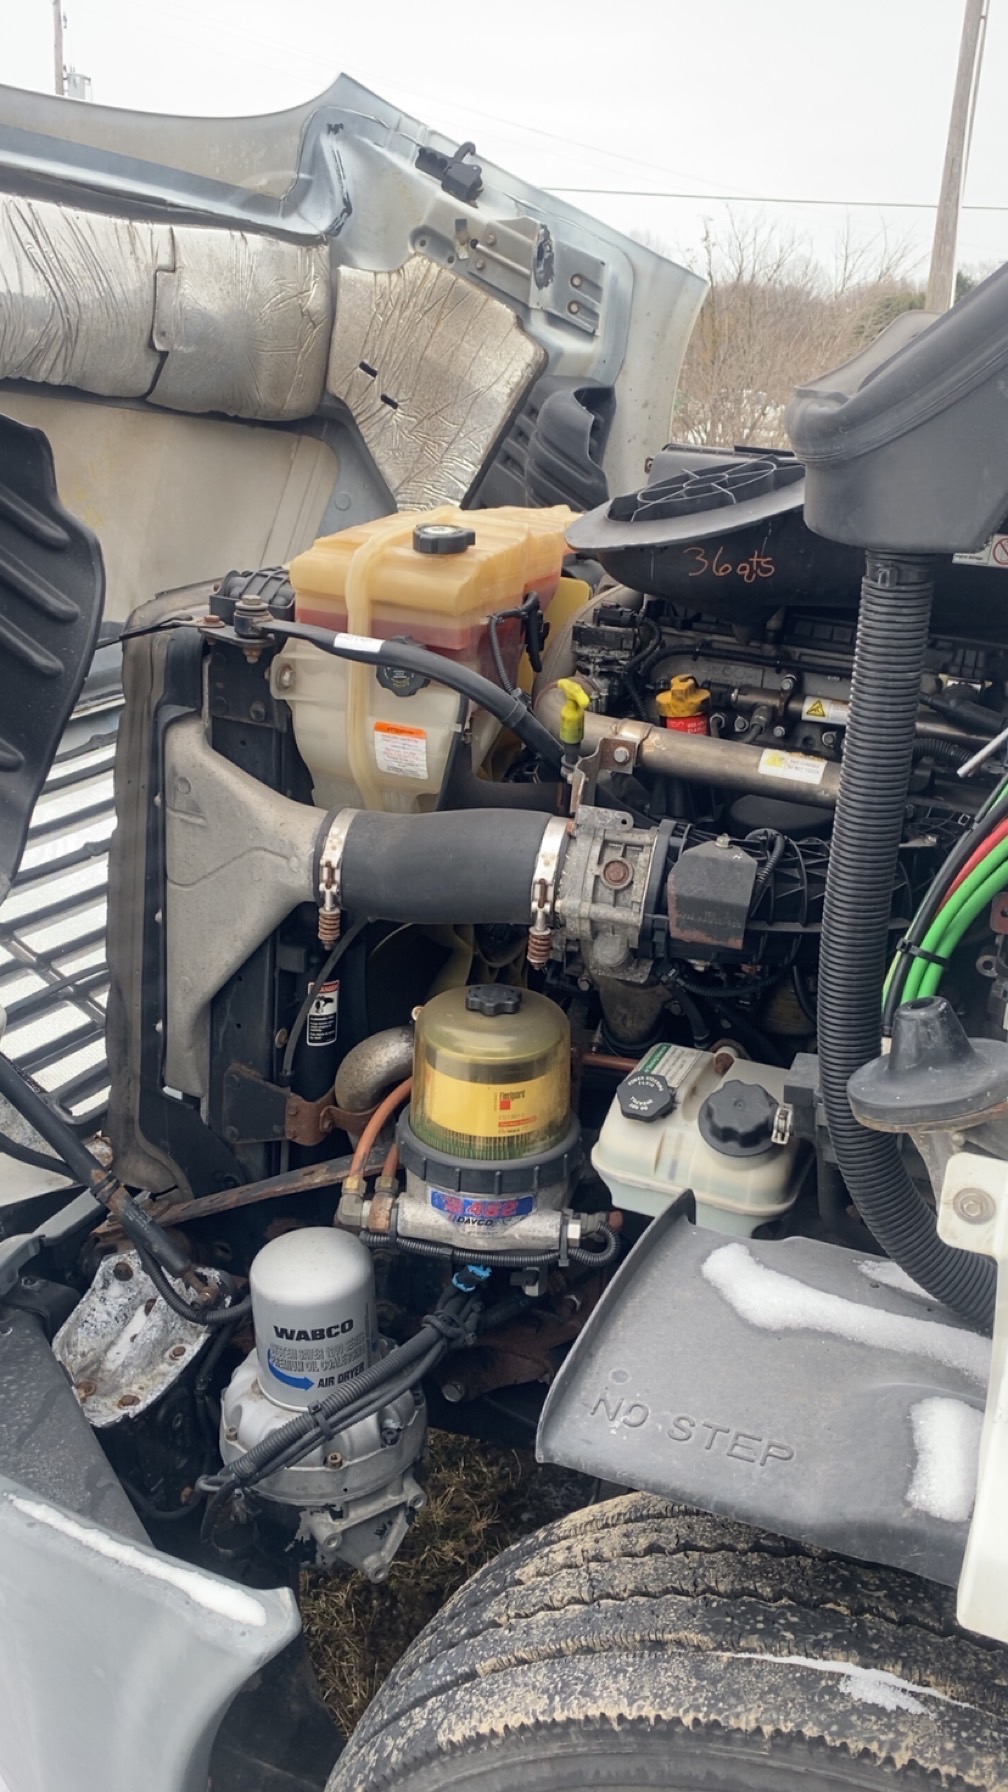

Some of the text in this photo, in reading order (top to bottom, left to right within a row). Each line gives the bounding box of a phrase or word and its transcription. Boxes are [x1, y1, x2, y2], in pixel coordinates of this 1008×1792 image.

[457, 1216, 494, 1227] DAVCO
[273, 1318, 354, 1342] WABCO
[317, 1361, 365, 1389] AIR DRYER
[590, 1397, 795, 1467] NO STEP
